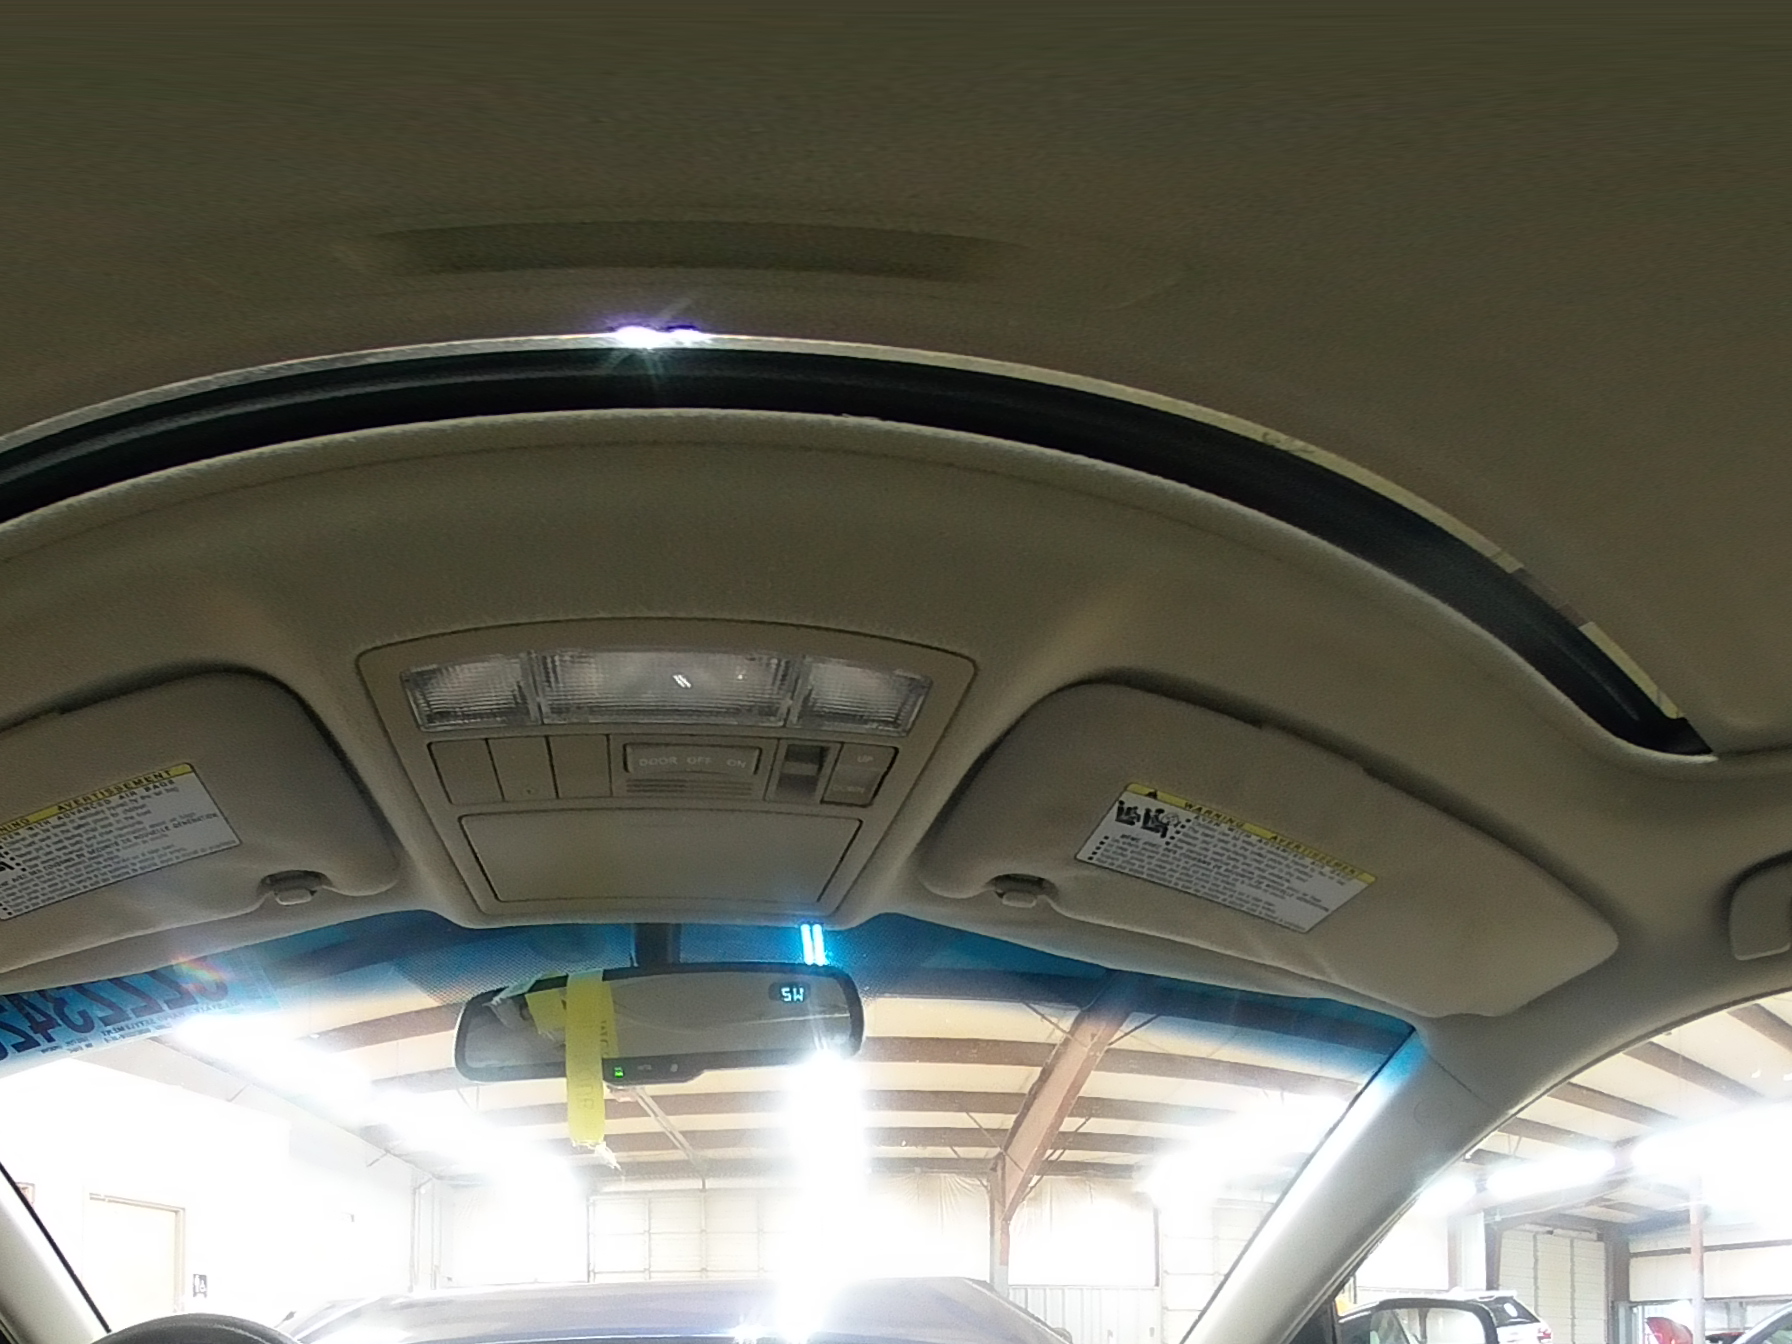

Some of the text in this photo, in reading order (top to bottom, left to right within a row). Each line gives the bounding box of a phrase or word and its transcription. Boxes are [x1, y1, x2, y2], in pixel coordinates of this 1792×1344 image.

[638, 756, 746, 768] DOOR OFF ON
[856, 754, 874, 764] UP
[57, 770, 172, 812] AVERTISSEMENT
[1185, 801, 1243, 828] WARNING
